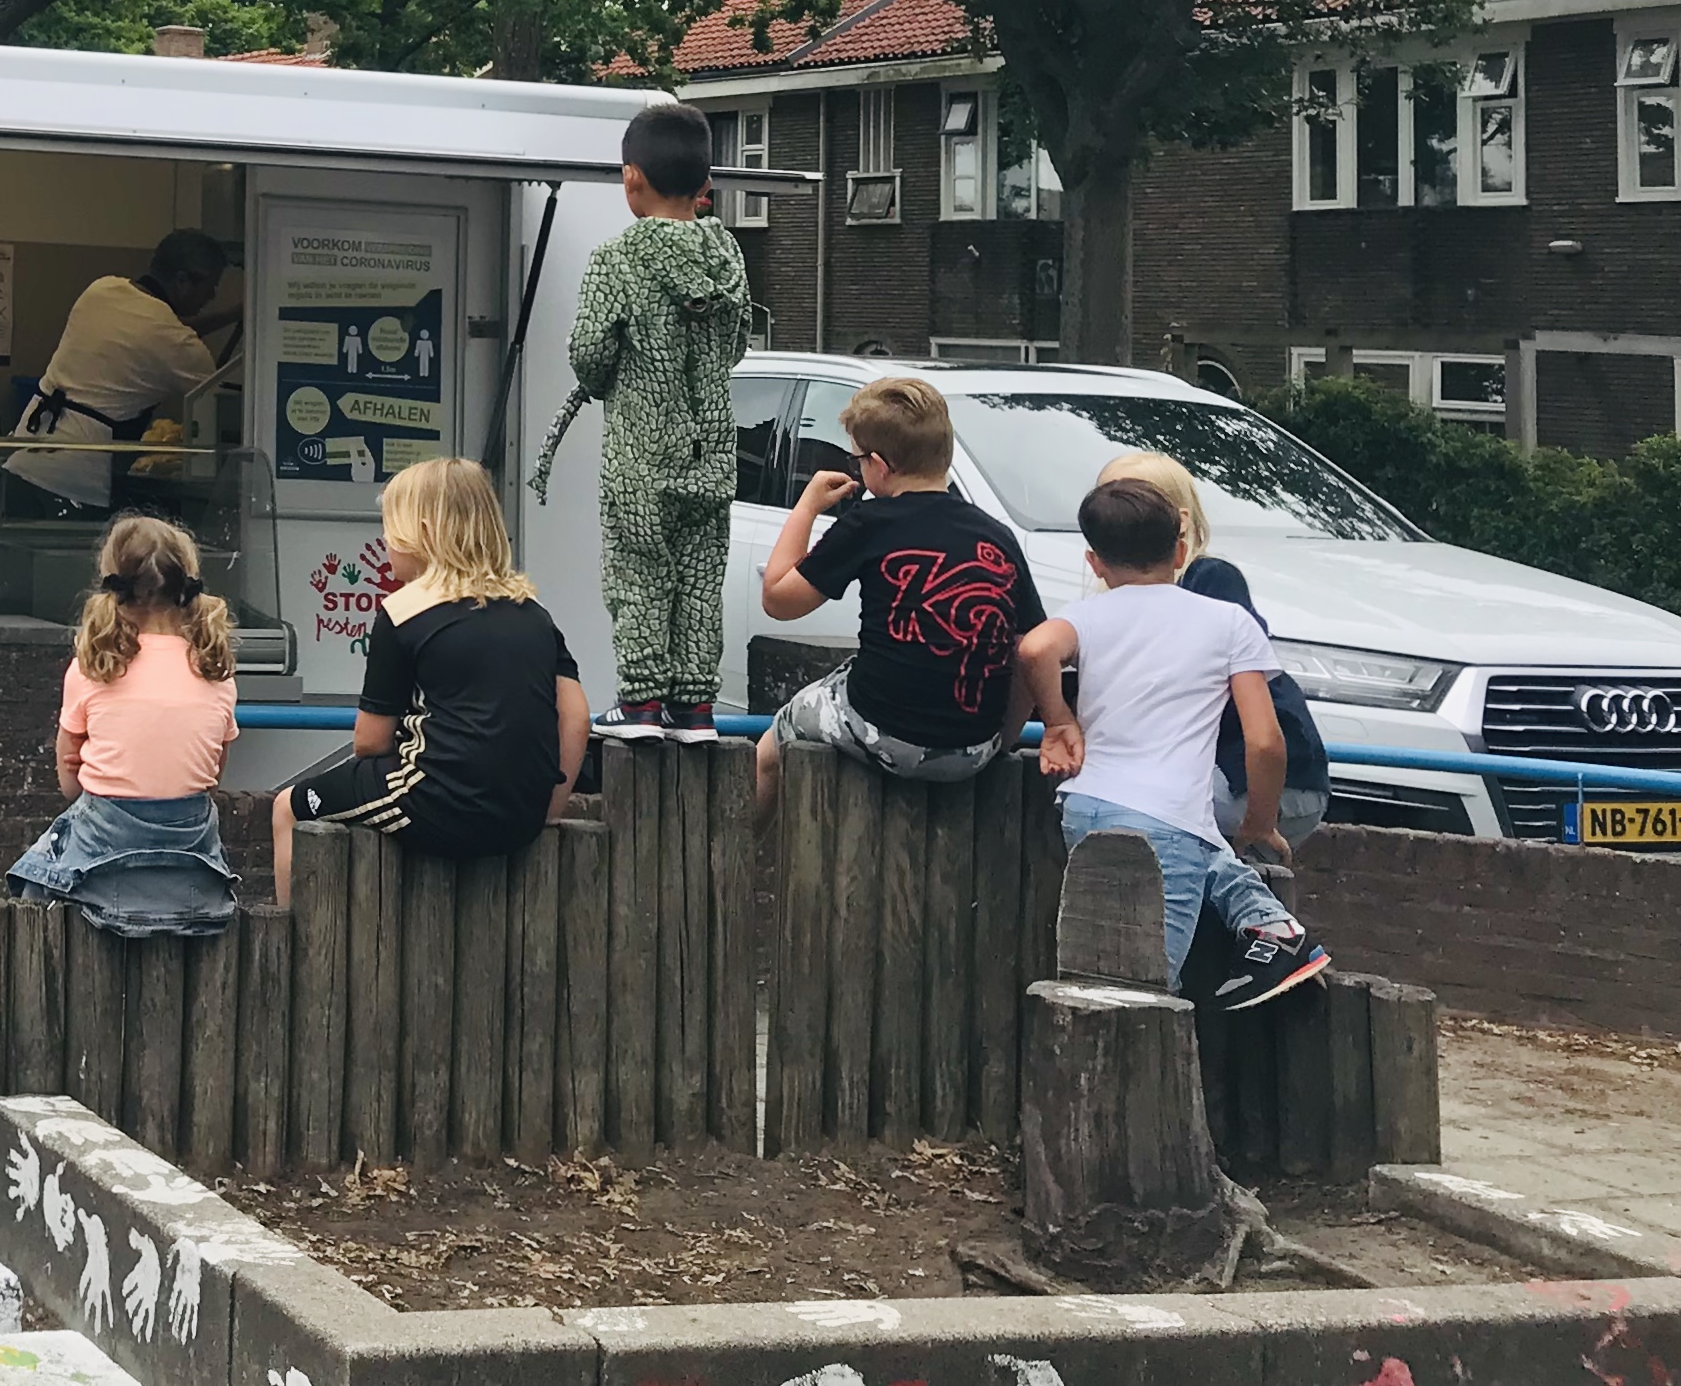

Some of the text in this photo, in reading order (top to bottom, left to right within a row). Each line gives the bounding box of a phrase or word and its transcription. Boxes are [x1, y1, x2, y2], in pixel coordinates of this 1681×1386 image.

[292, 237, 362, 252] VOORKOM
[340, 256, 430, 272] CORONAVIRUS
[350, 399, 430, 423] AFHALEN
[316, 613, 366, 641] pesten
[1565, 825, 1576, 835] NL
[1590, 807, 1681, 837] NB-761
